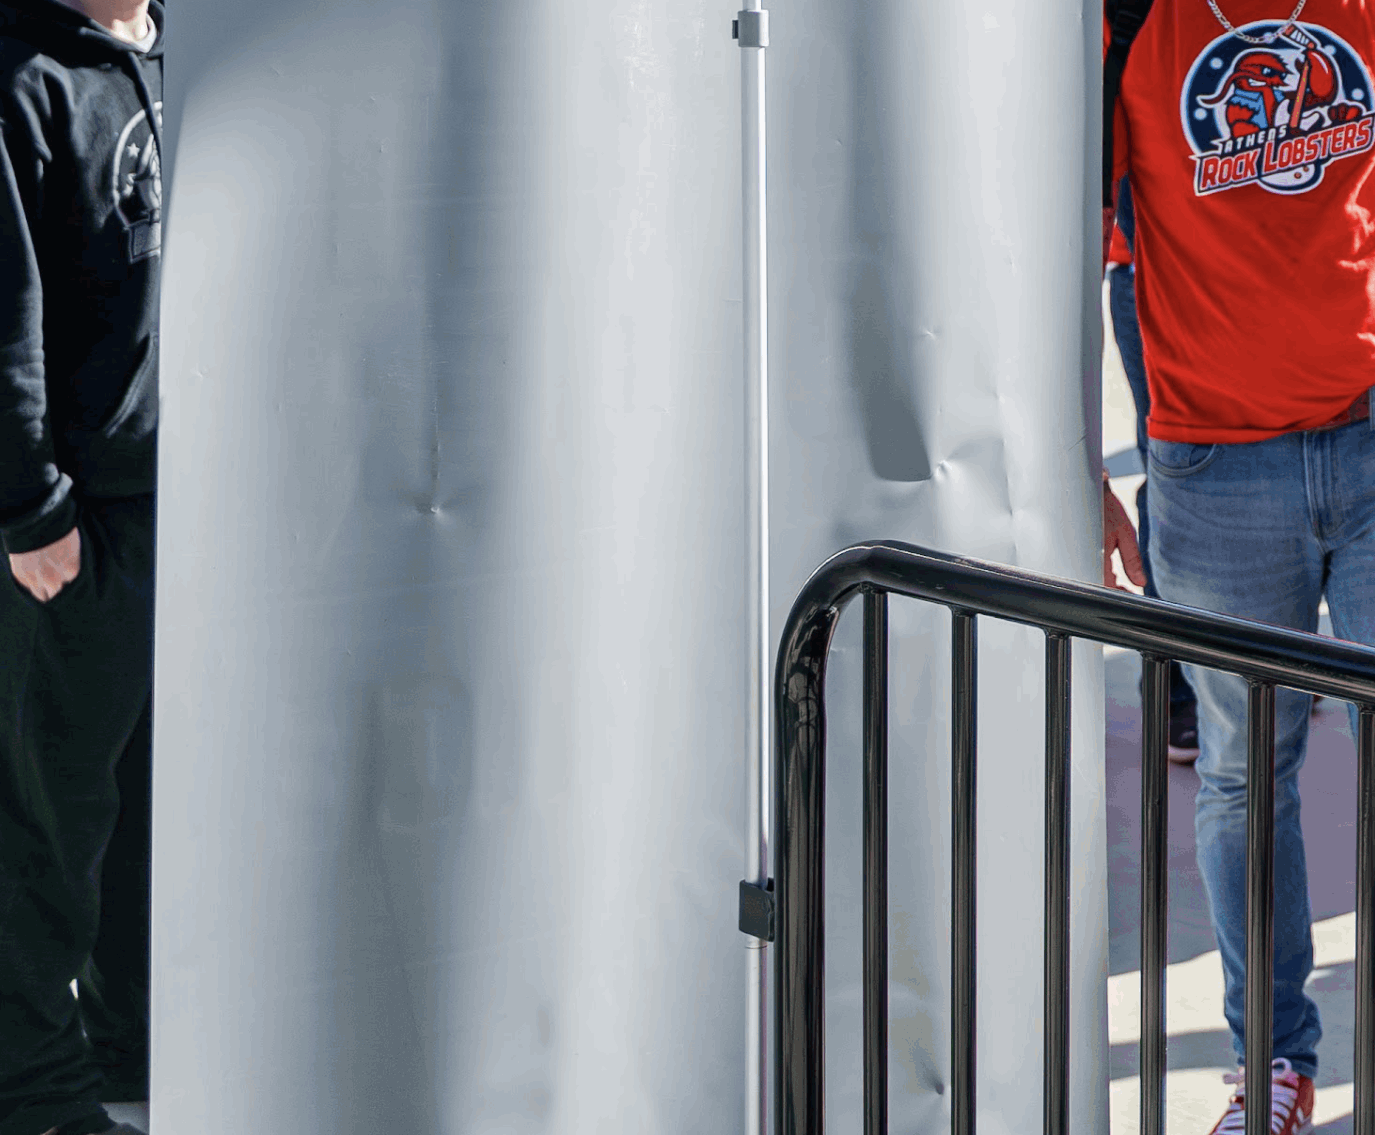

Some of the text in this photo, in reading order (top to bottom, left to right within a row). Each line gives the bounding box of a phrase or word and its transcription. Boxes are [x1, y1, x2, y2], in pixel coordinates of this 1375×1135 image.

[1200, 118, 1373, 191] ROCK LOBSTERS
[1224, 125, 1287, 153] ATHENS
